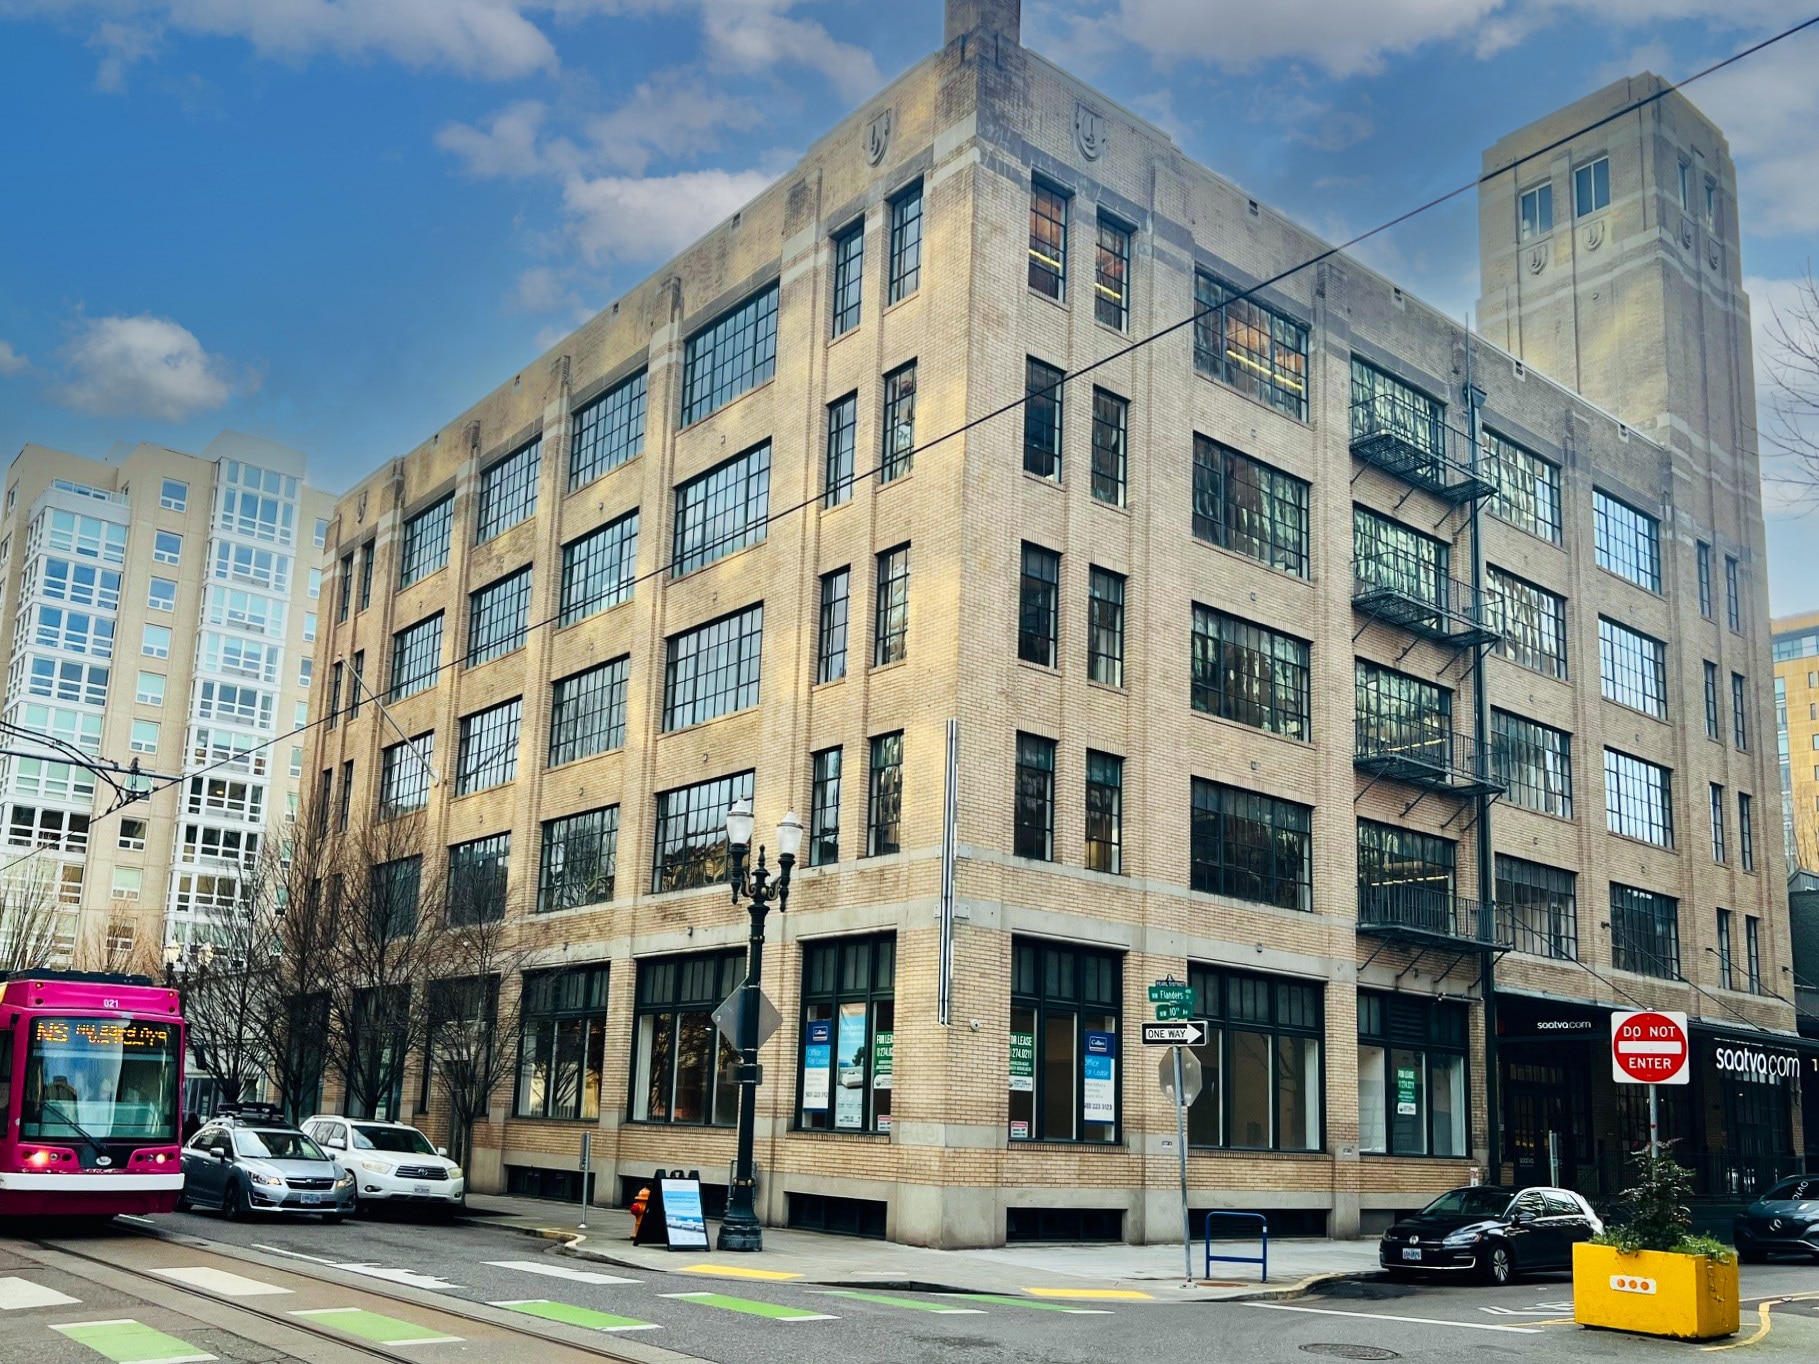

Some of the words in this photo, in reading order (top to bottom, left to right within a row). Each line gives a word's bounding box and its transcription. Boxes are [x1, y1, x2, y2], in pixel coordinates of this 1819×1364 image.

[1160, 990, 1183, 999] Flanders
[103, 999, 119, 1008] 021
[36, 1022, 69, 1042] NS
[1148, 1029, 1166, 1039] ONE
[1167, 1029, 1186, 1039] WAY
[1623, 1026, 1642, 1038] DO
[1649, 1026, 1676, 1038] NOT
[1018, 1035, 1032, 1046] LEASE
[1628, 1057, 1672, 1070] ENTER
